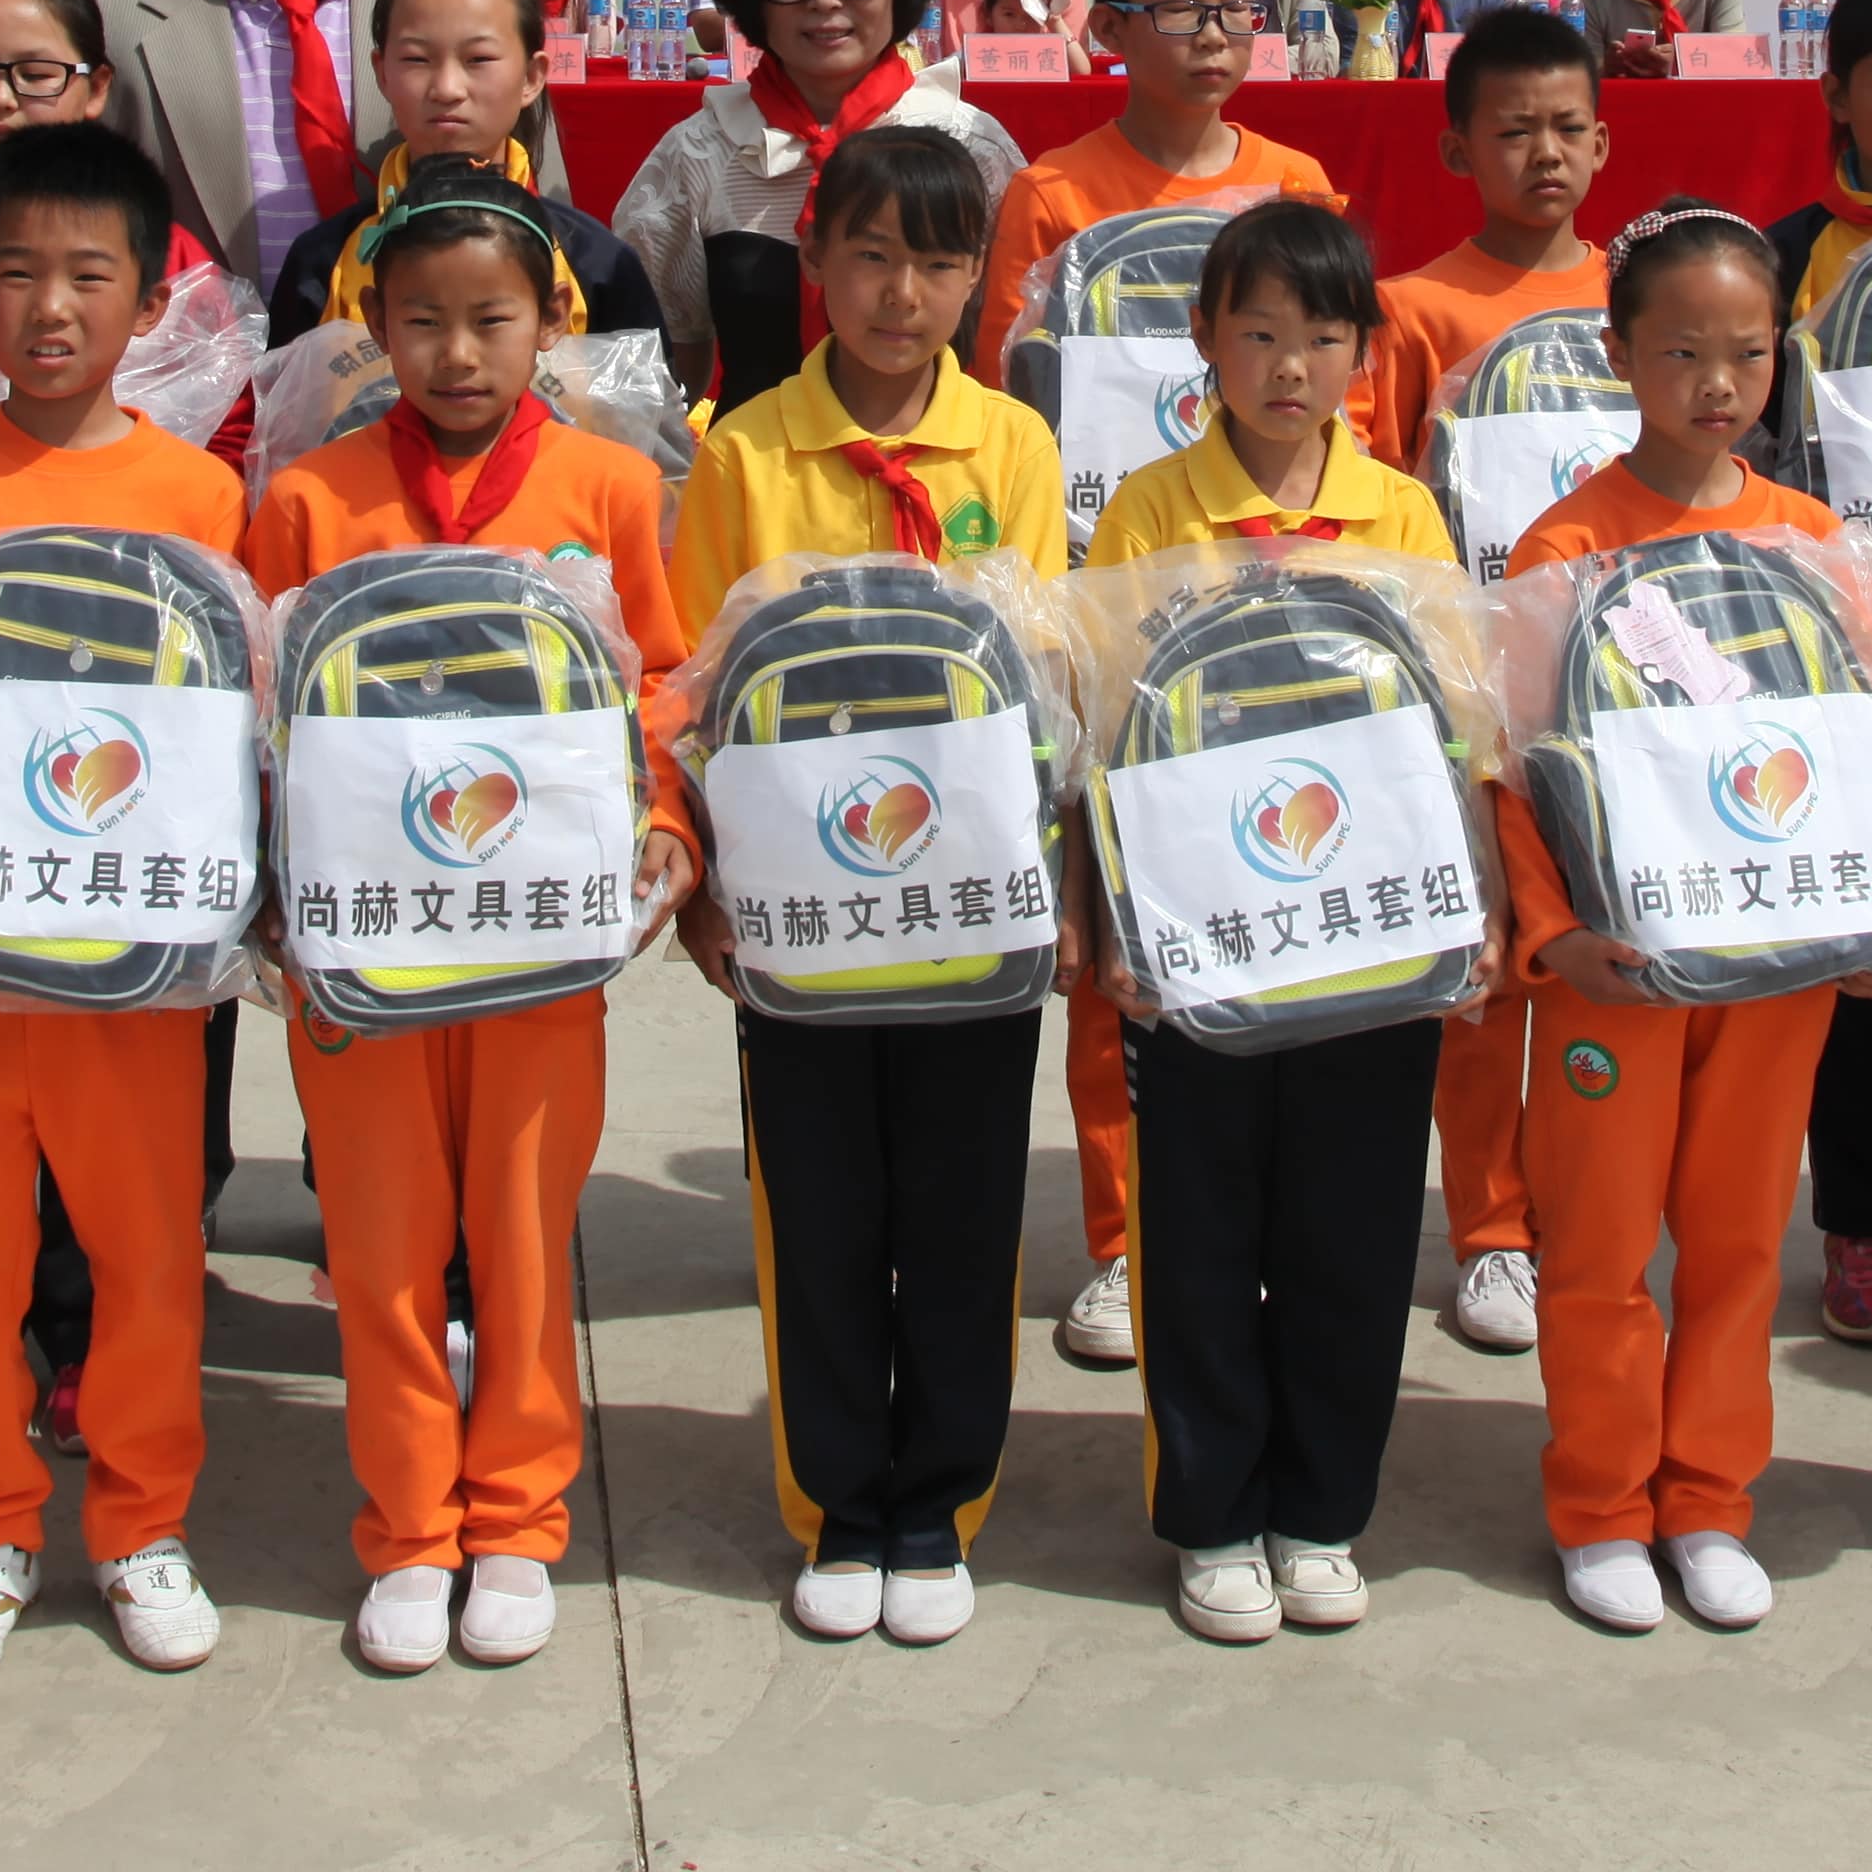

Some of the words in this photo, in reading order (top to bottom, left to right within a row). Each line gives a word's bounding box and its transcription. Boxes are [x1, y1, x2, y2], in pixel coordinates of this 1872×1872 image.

[975, 47, 1063, 73] 董丽霞
[117, 786, 147, 817] HOPE
[499, 815, 526, 848] HOPE
[917, 822, 941, 855] HOPE
[297, 872, 624, 937] 尚赫文具套组
[736, 866, 1050, 948] 尚赫文具套组
[1155, 862, 1470, 979] 尚赫文具套组
[146, 1565, 177, 1590] 道
